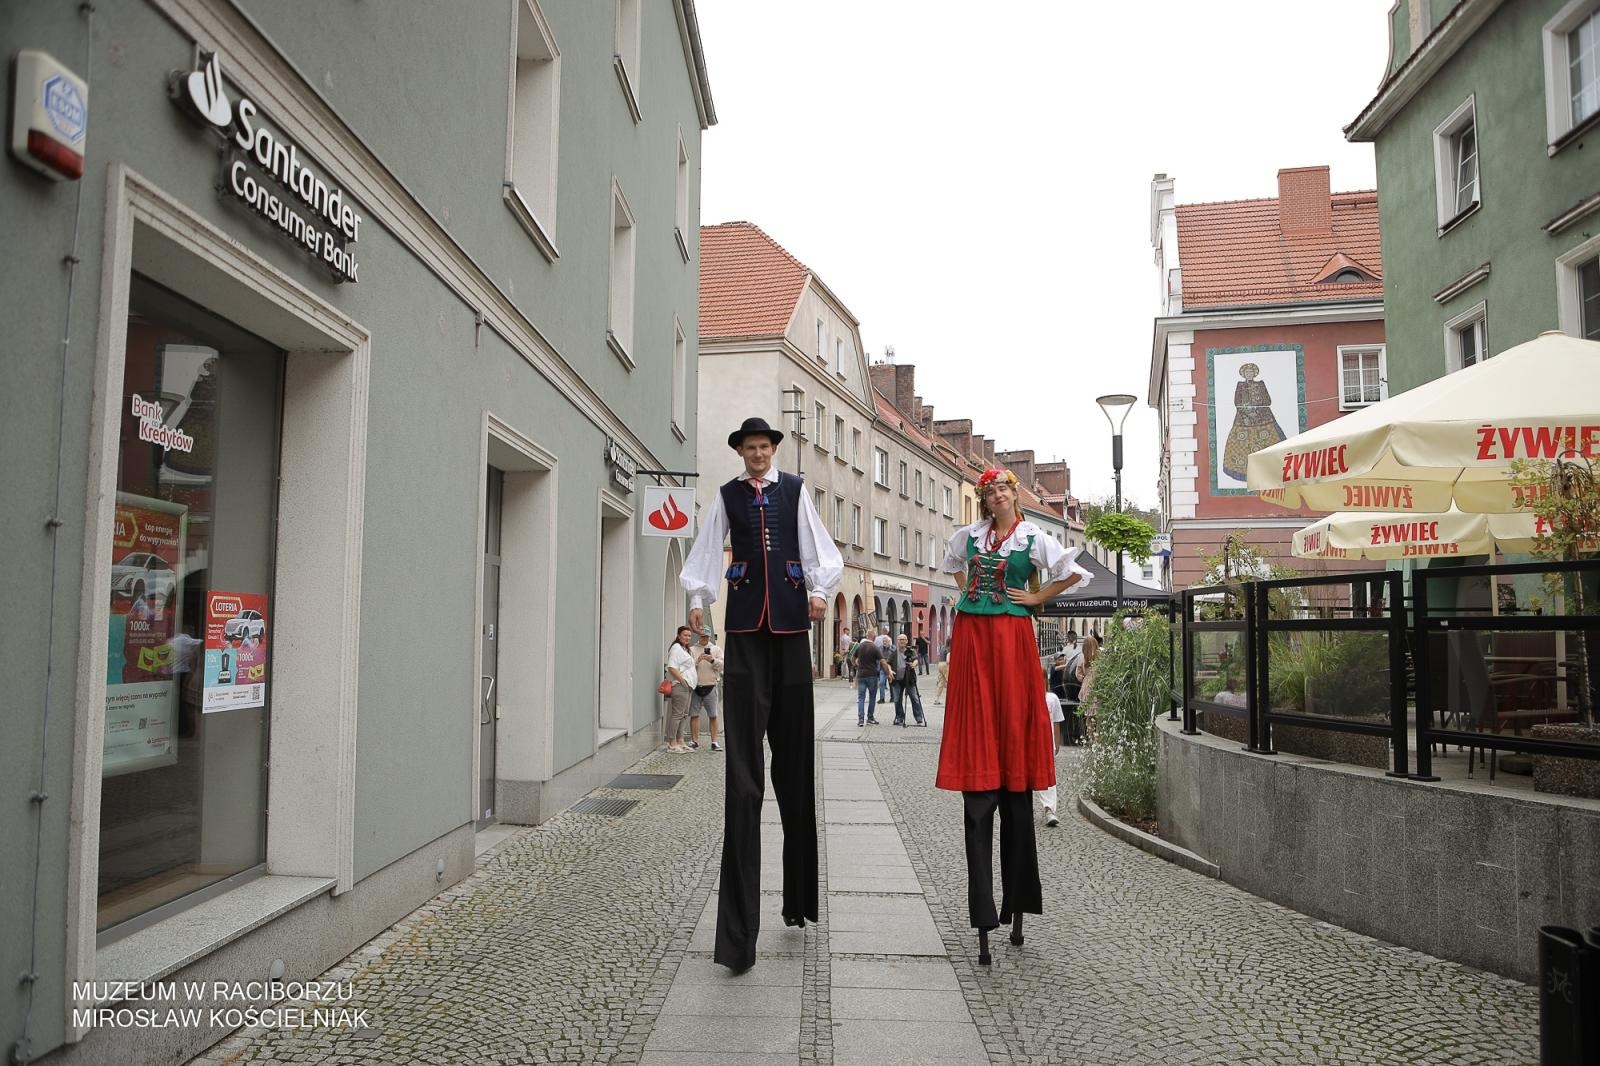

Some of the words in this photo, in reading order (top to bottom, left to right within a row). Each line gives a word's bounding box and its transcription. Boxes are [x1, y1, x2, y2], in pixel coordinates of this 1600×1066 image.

[236, 99, 361, 242] Santander
[231, 160, 323, 253] Consumer
[323, 231, 359, 283] Bank
[133, 397, 161, 422] Bank
[141, 420, 193, 451] Kredytów
[1476, 424, 1600, 460] ŻYWIE
[1282, 444, 1349, 482] ŻYWIEC
[1371, 521, 1439, 545] ŻYWIEC
[215, 602, 238, 612] LOTERIA
[1056, 599, 1147, 608] www.muzeum.gwice.pl
[130, 620, 151, 631] 1000x
